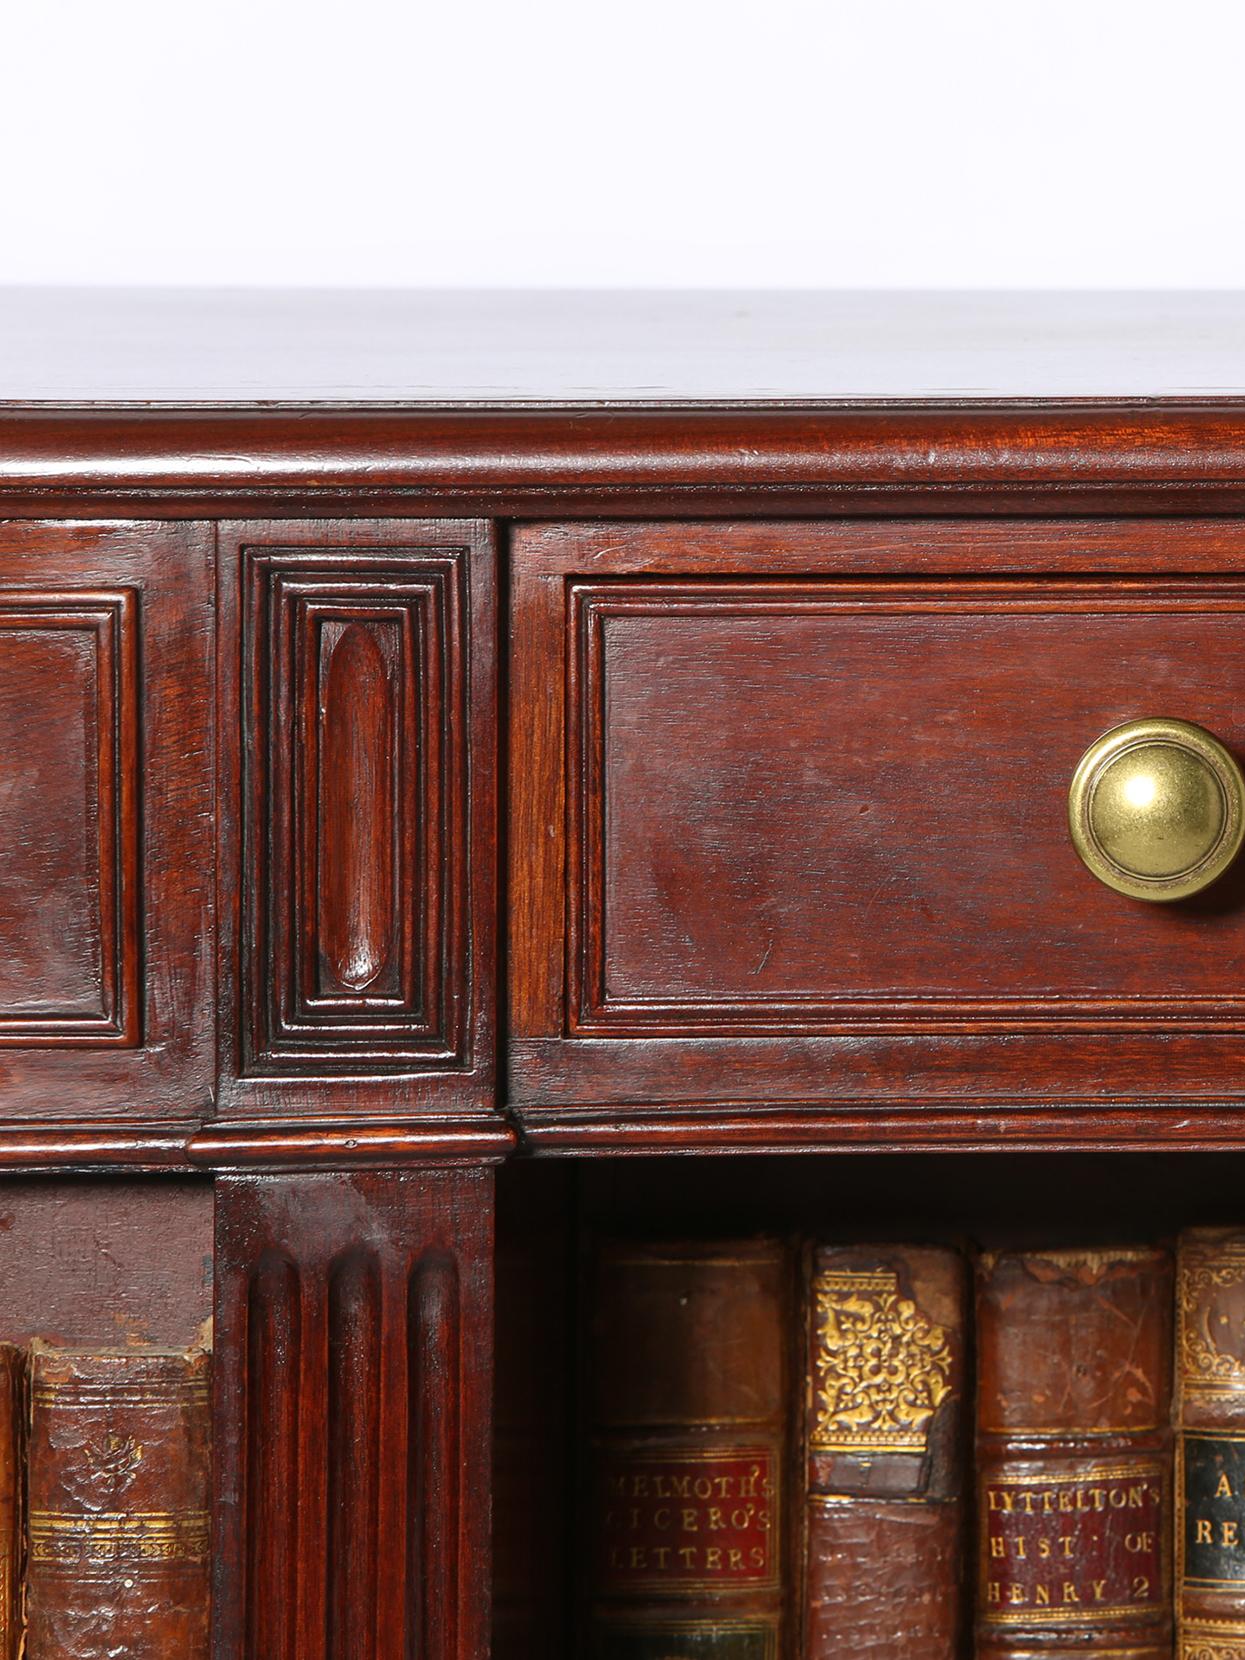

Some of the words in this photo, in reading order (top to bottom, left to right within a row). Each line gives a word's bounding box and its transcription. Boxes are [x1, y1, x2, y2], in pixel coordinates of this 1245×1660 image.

[988, 1483, 1160, 1514] LYTTELTON'S
[610, 1546, 765, 1570] LETTERS
[987, 1579, 1107, 1605] HENRY
[1132, 1575, 1149, 1599] 2
